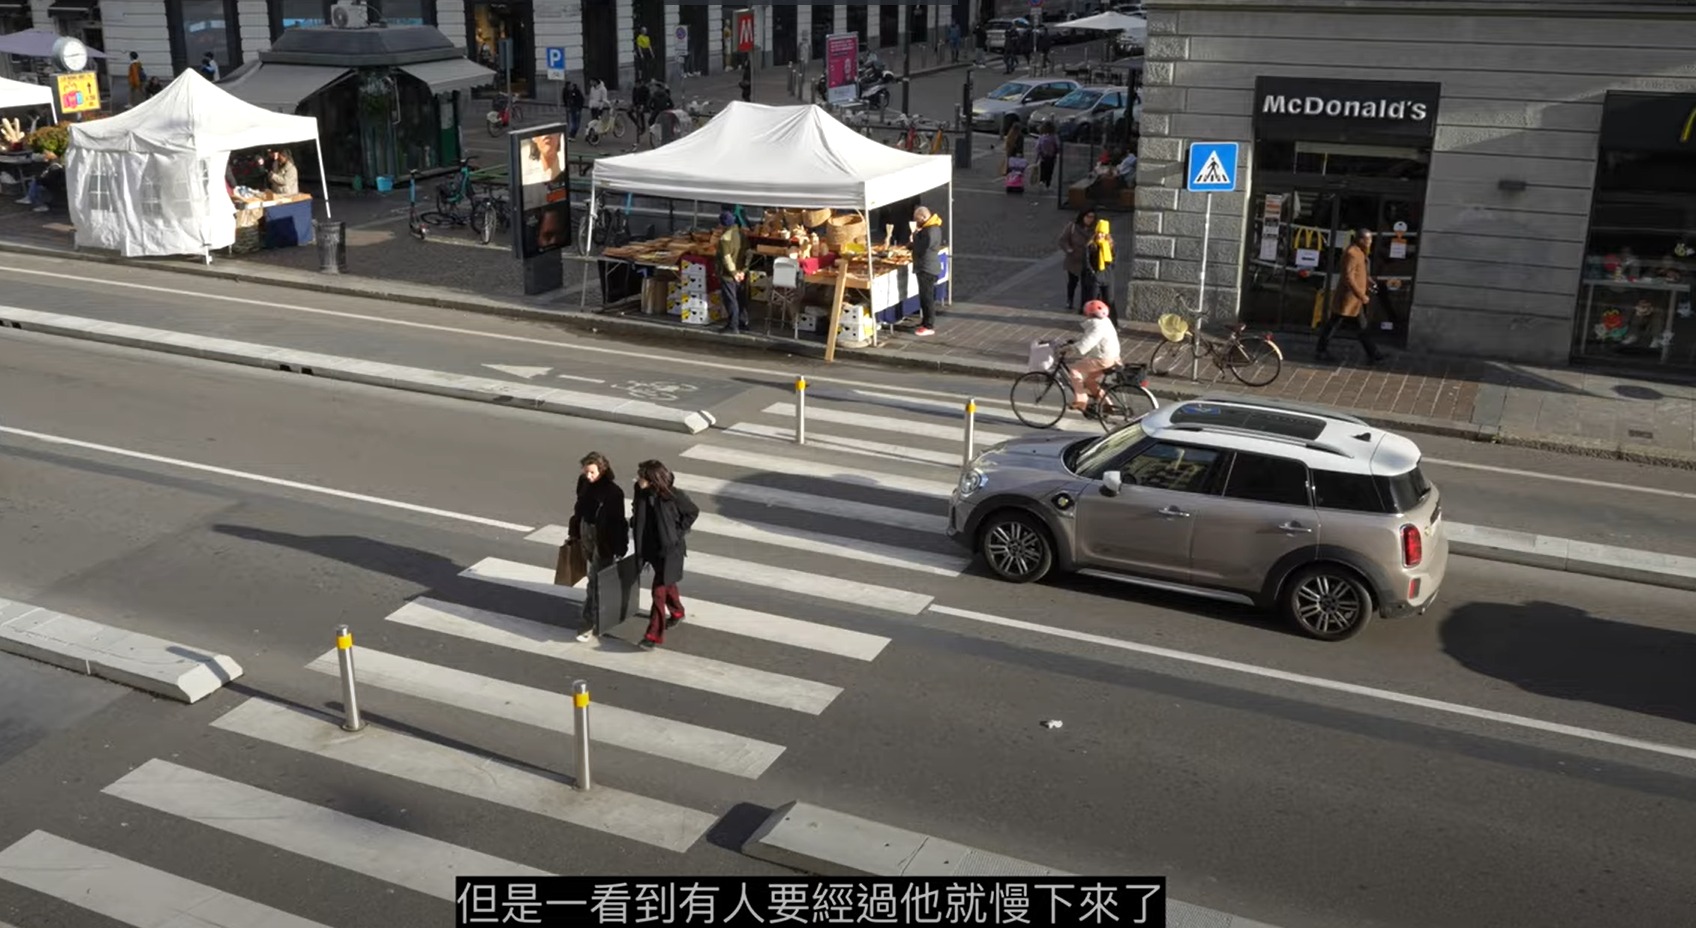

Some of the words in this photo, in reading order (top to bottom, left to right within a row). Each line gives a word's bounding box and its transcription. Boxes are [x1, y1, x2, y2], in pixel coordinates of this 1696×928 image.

[740, 19, 753, 44] M
[549, 49, 561, 67] P
[1262, 95, 1427, 120] McDonald's
